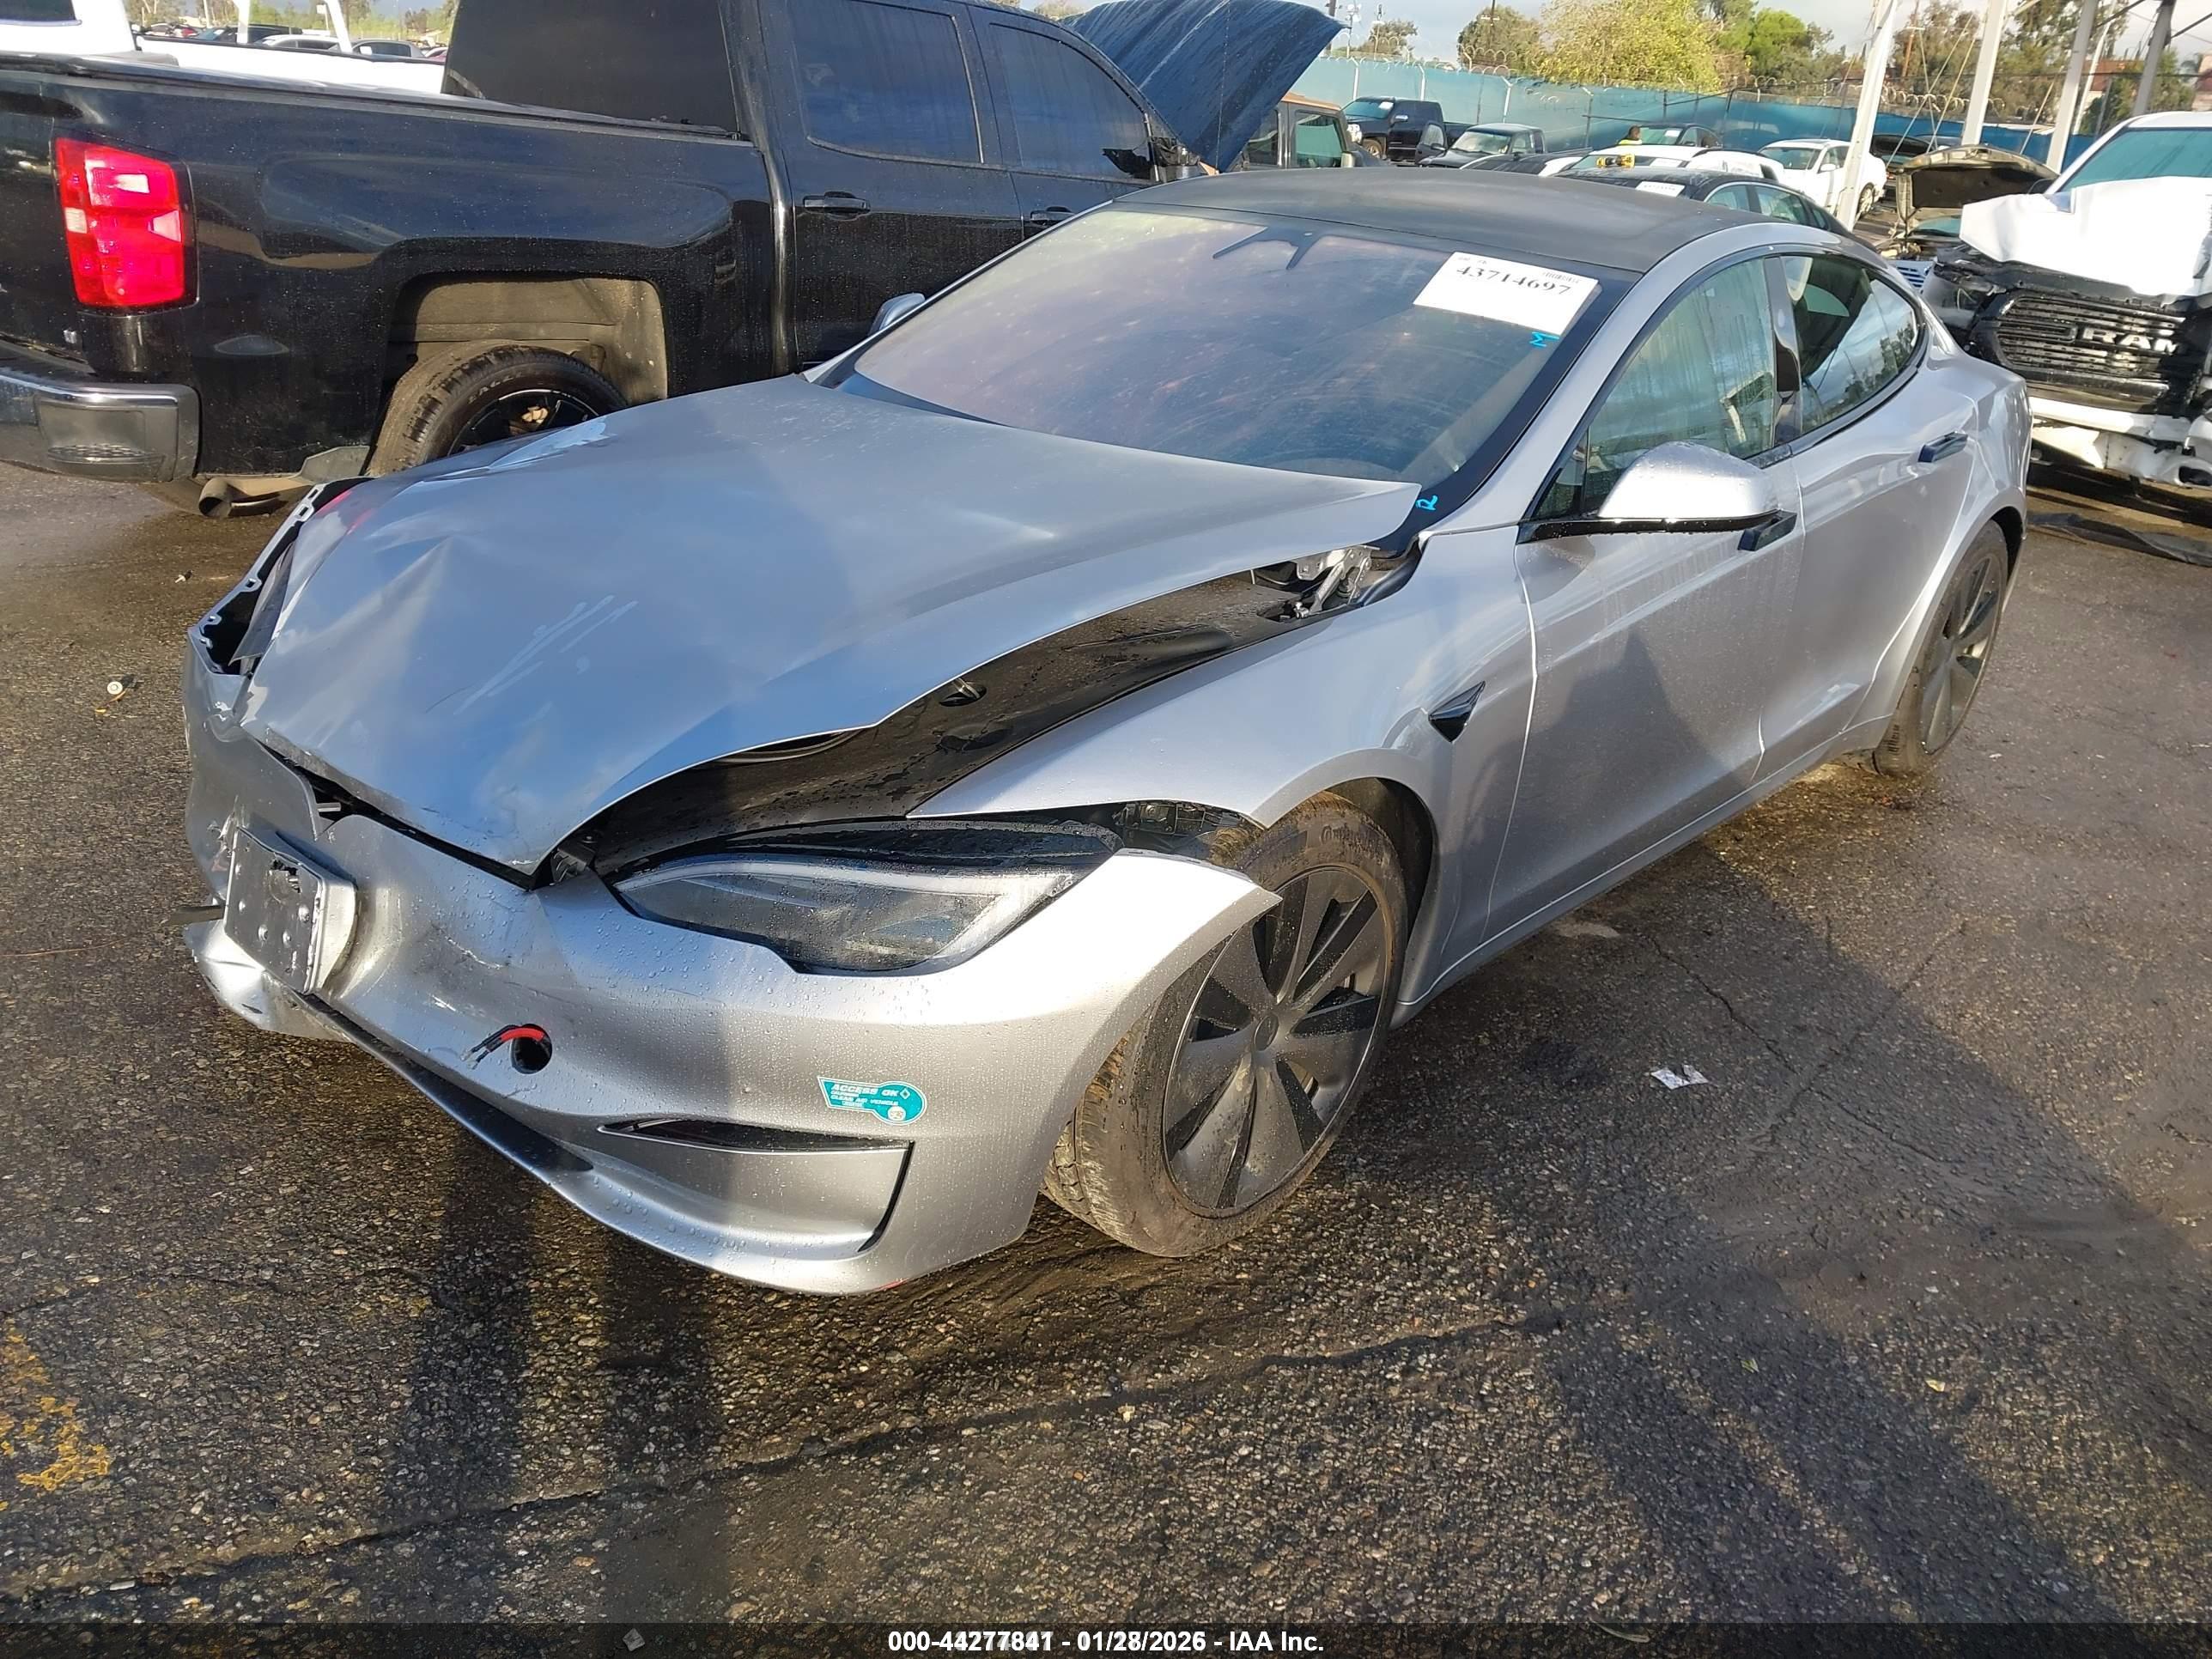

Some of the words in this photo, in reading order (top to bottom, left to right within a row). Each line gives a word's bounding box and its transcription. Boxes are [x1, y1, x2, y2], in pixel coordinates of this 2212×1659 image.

[1455, 265, 1571, 295] 43714697
[2082, 327, 2179, 355] RAM
[830, 1084, 878, 1095] ACCESS
